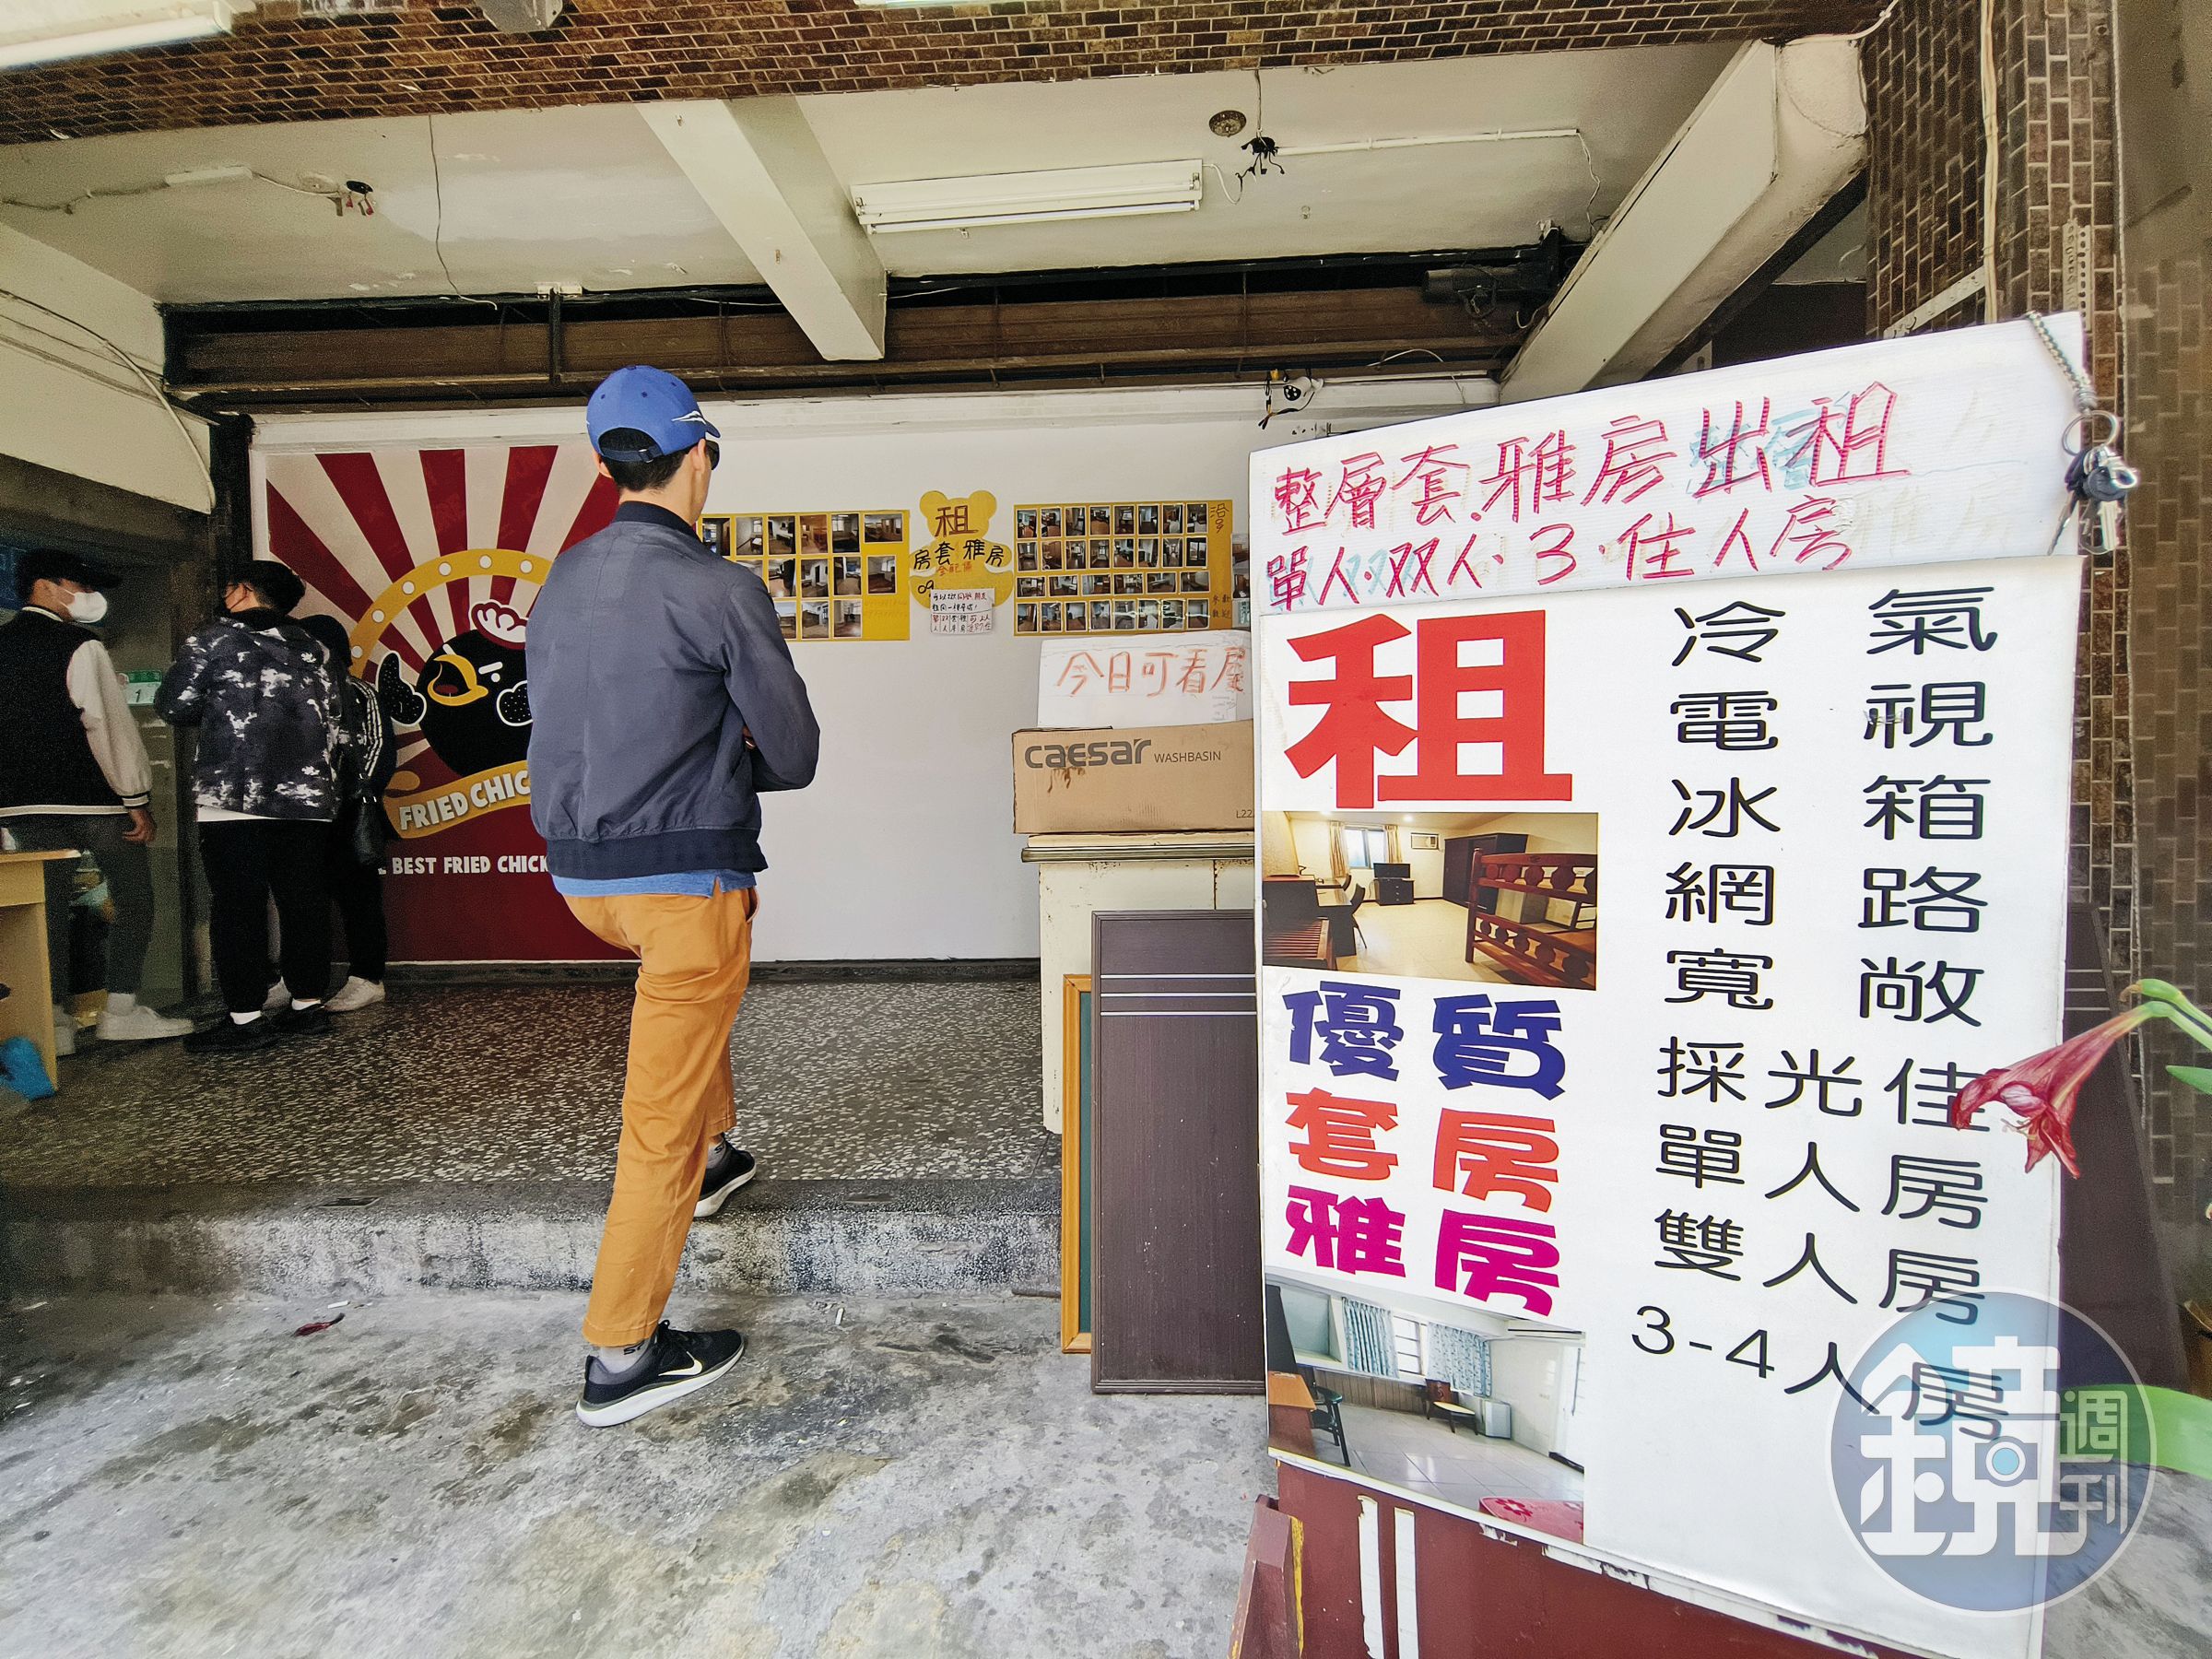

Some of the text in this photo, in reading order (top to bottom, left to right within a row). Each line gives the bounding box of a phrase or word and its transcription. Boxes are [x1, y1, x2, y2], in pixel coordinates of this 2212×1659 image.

[935, 505, 979, 537] 租
[1672, 587, 1998, 666] 冷氣
[1284, 610, 1572, 808] 租
[1670, 681, 1994, 751] 電視
[1024, 739, 1221, 769] caesar WASHBASIN
[399, 792, 469, 830] FRIED
[1668, 774, 1991, 841] 冰箱
[392, 857, 437, 875] BEST
[443, 856, 491, 874] FRIED
[1665, 862, 1989, 933] 網路
[1664, 947, 1985, 1028] 寬敞
[1282, 981, 1566, 1100] 優質
[1657, 1036, 1990, 1133] 採光佳
[1285, 1087, 1559, 1213] 套房
[1655, 1124, 1989, 1230] 單人房
[1285, 1184, 1560, 1317] 雅房
[1653, 1208, 1985, 1325] 雙人房
